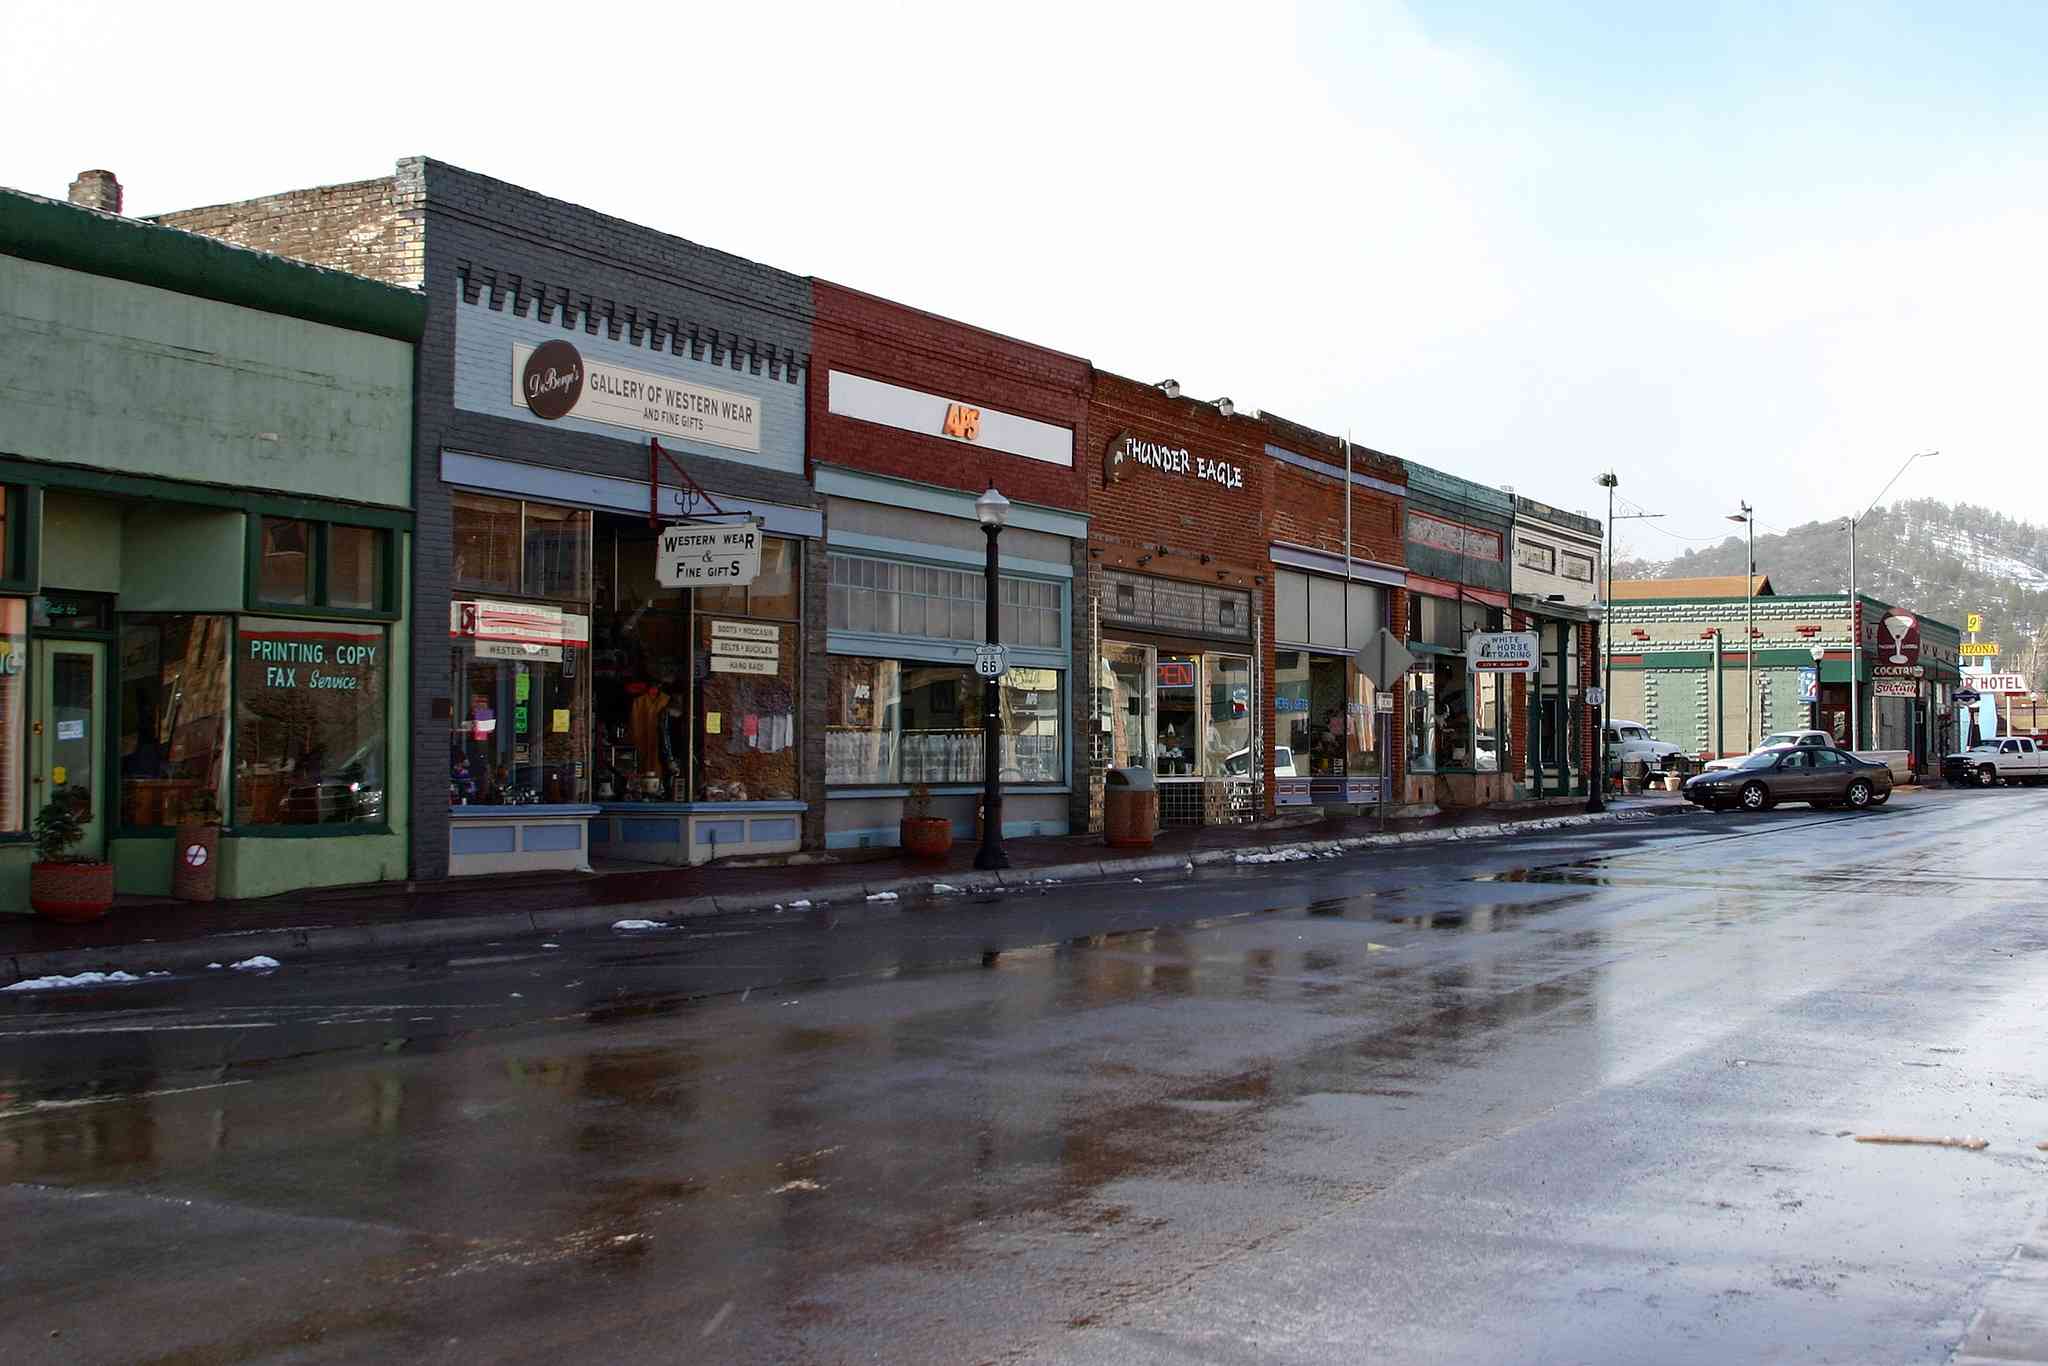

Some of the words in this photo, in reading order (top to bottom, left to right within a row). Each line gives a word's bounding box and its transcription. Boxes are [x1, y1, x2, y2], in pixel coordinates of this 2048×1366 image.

[590, 373, 645, 401] GALLERY
[648, 385, 662, 405] OF
[665, 388, 719, 417] WESTERN
[721, 400, 753, 424] WEAR
[643, 407, 660, 421] AND
[661, 411, 680, 426] FINE
[681, 415, 704, 431] GIFTS
[1125, 438, 1190, 475] THUNDER
[1197, 457, 1242, 488] EAGLE
[664, 535, 716, 553] WESTERN
[723, 533, 755, 549] WEAR
[702, 550, 713, 563] &
[676, 562, 702, 578] FINE
[708, 560, 740, 576] GIFTS
[336, 646, 377, 665] COPY
[1497, 643, 1528, 651] HORSE
[1959, 645, 1996, 655] RIZONA
[982, 661, 997, 673] 66
[1157, 664, 1192, 684] PEN
[267, 667, 296, 688] FAX
[309, 669, 358, 690] Service
[1981, 676, 2022, 689] HOTEL
